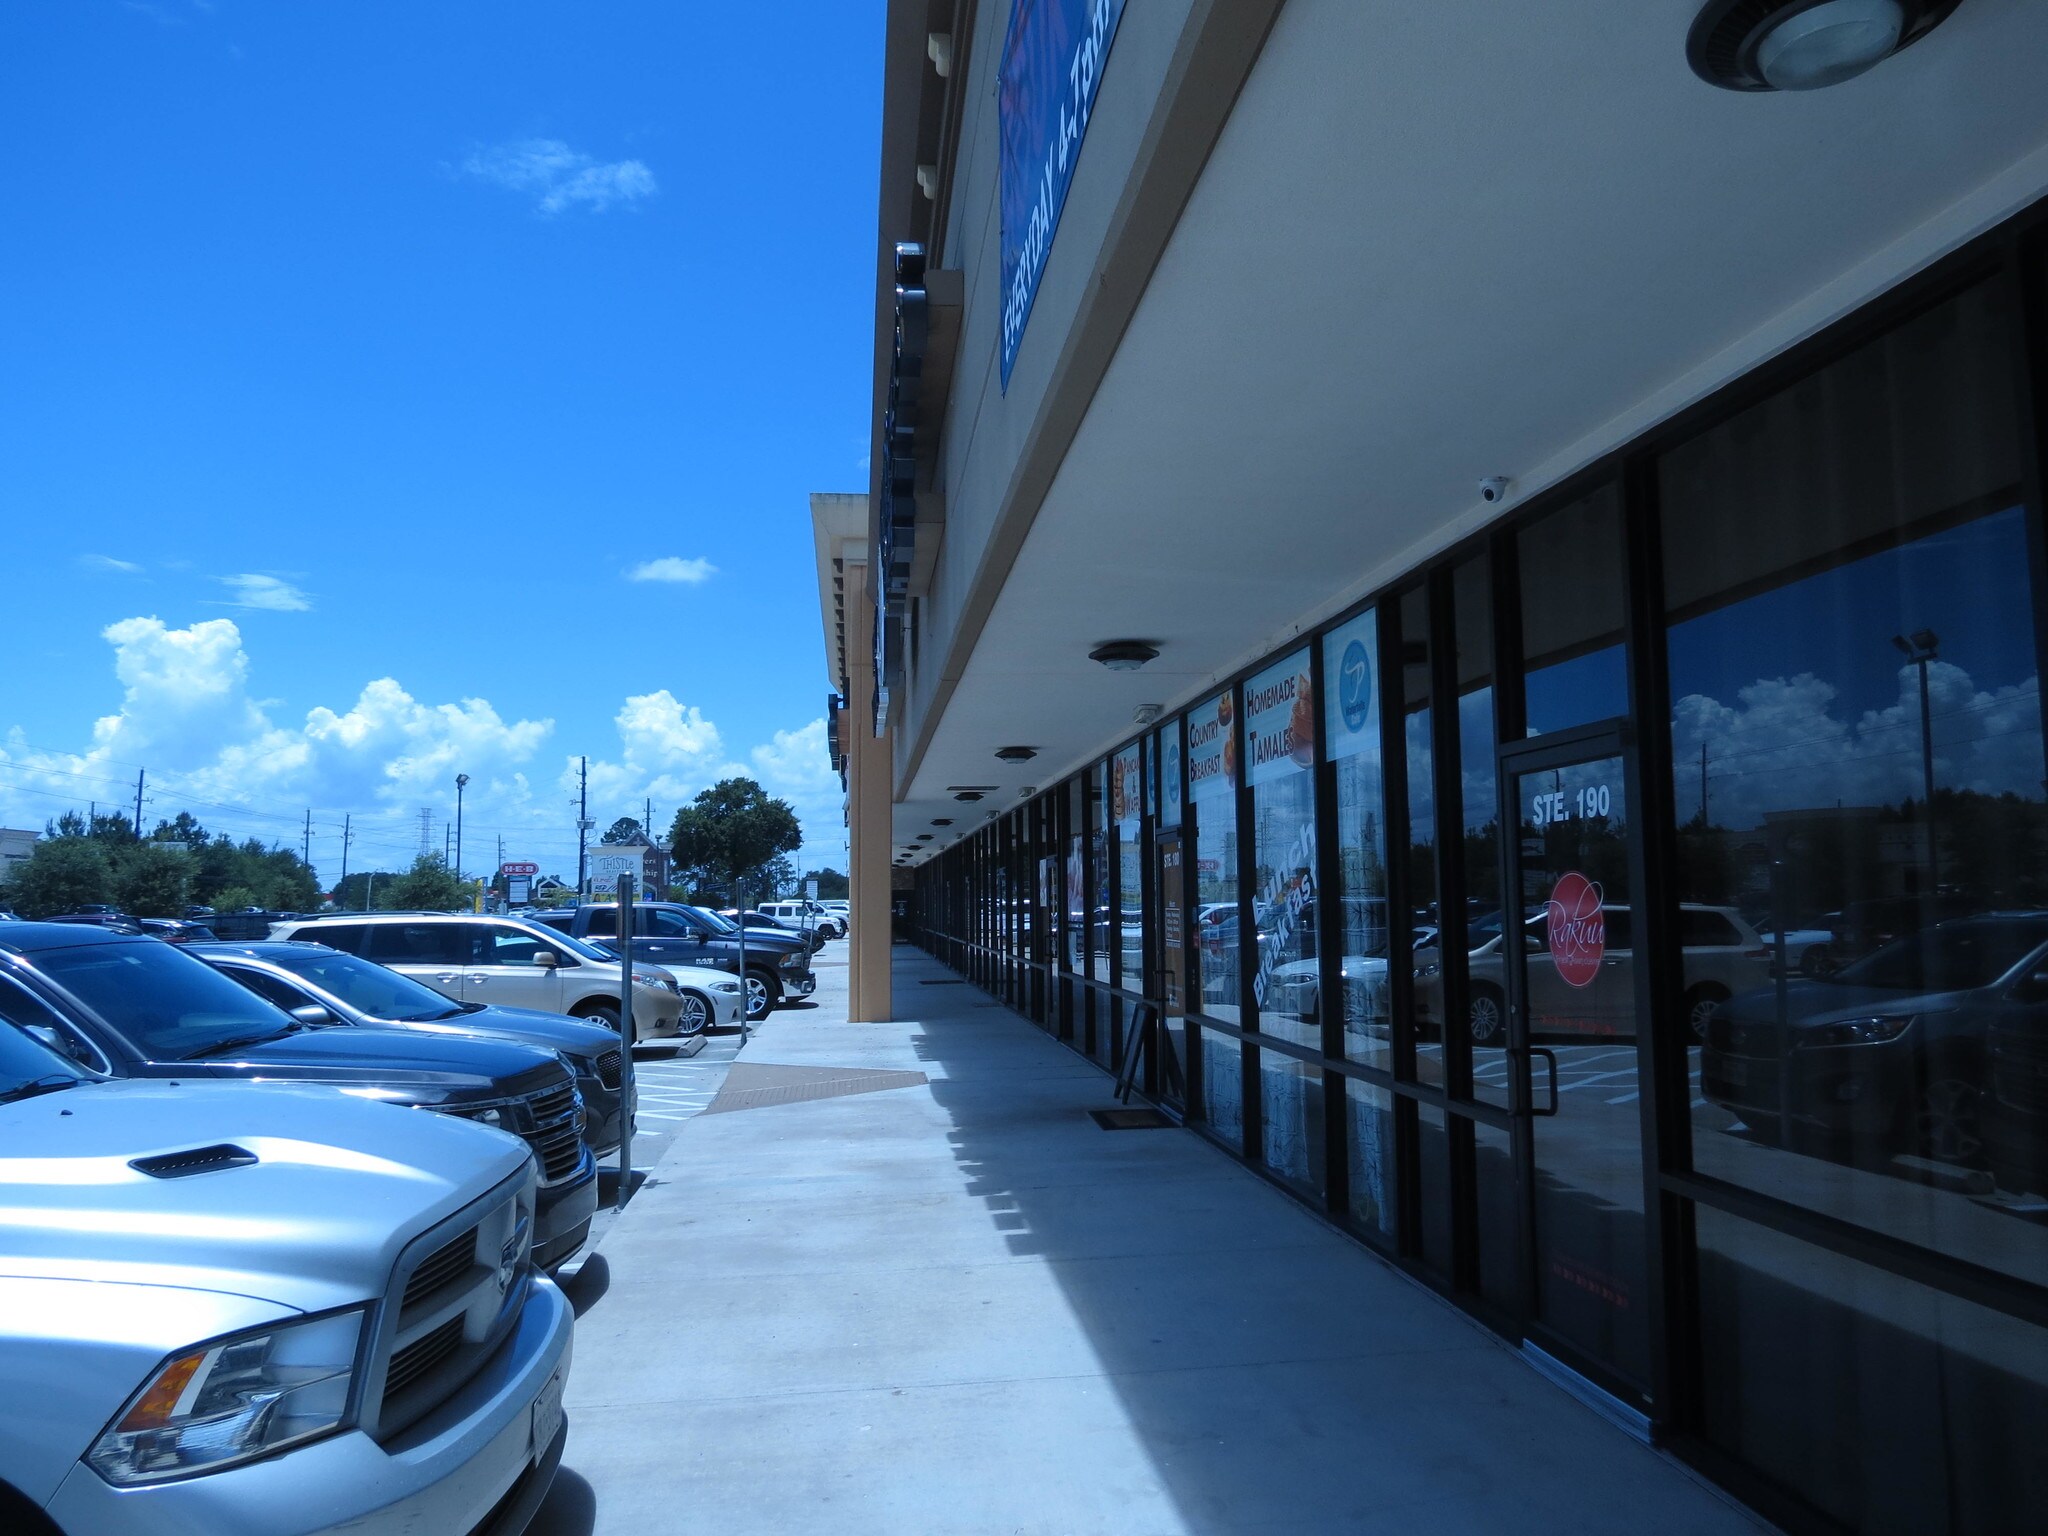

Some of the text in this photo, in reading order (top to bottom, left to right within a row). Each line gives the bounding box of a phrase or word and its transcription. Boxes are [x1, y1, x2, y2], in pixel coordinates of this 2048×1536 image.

[1003, 142, 1054, 363] EVERYDAY
[1246, 676, 1295, 719] HOMEMADE
[1189, 718, 1219, 749] COUNTRY
[1249, 727, 1294, 767] TAMALES
[1190, 754, 1221, 783] BREAKFAST
[1533, 785, 1610, 825] STE. 190
